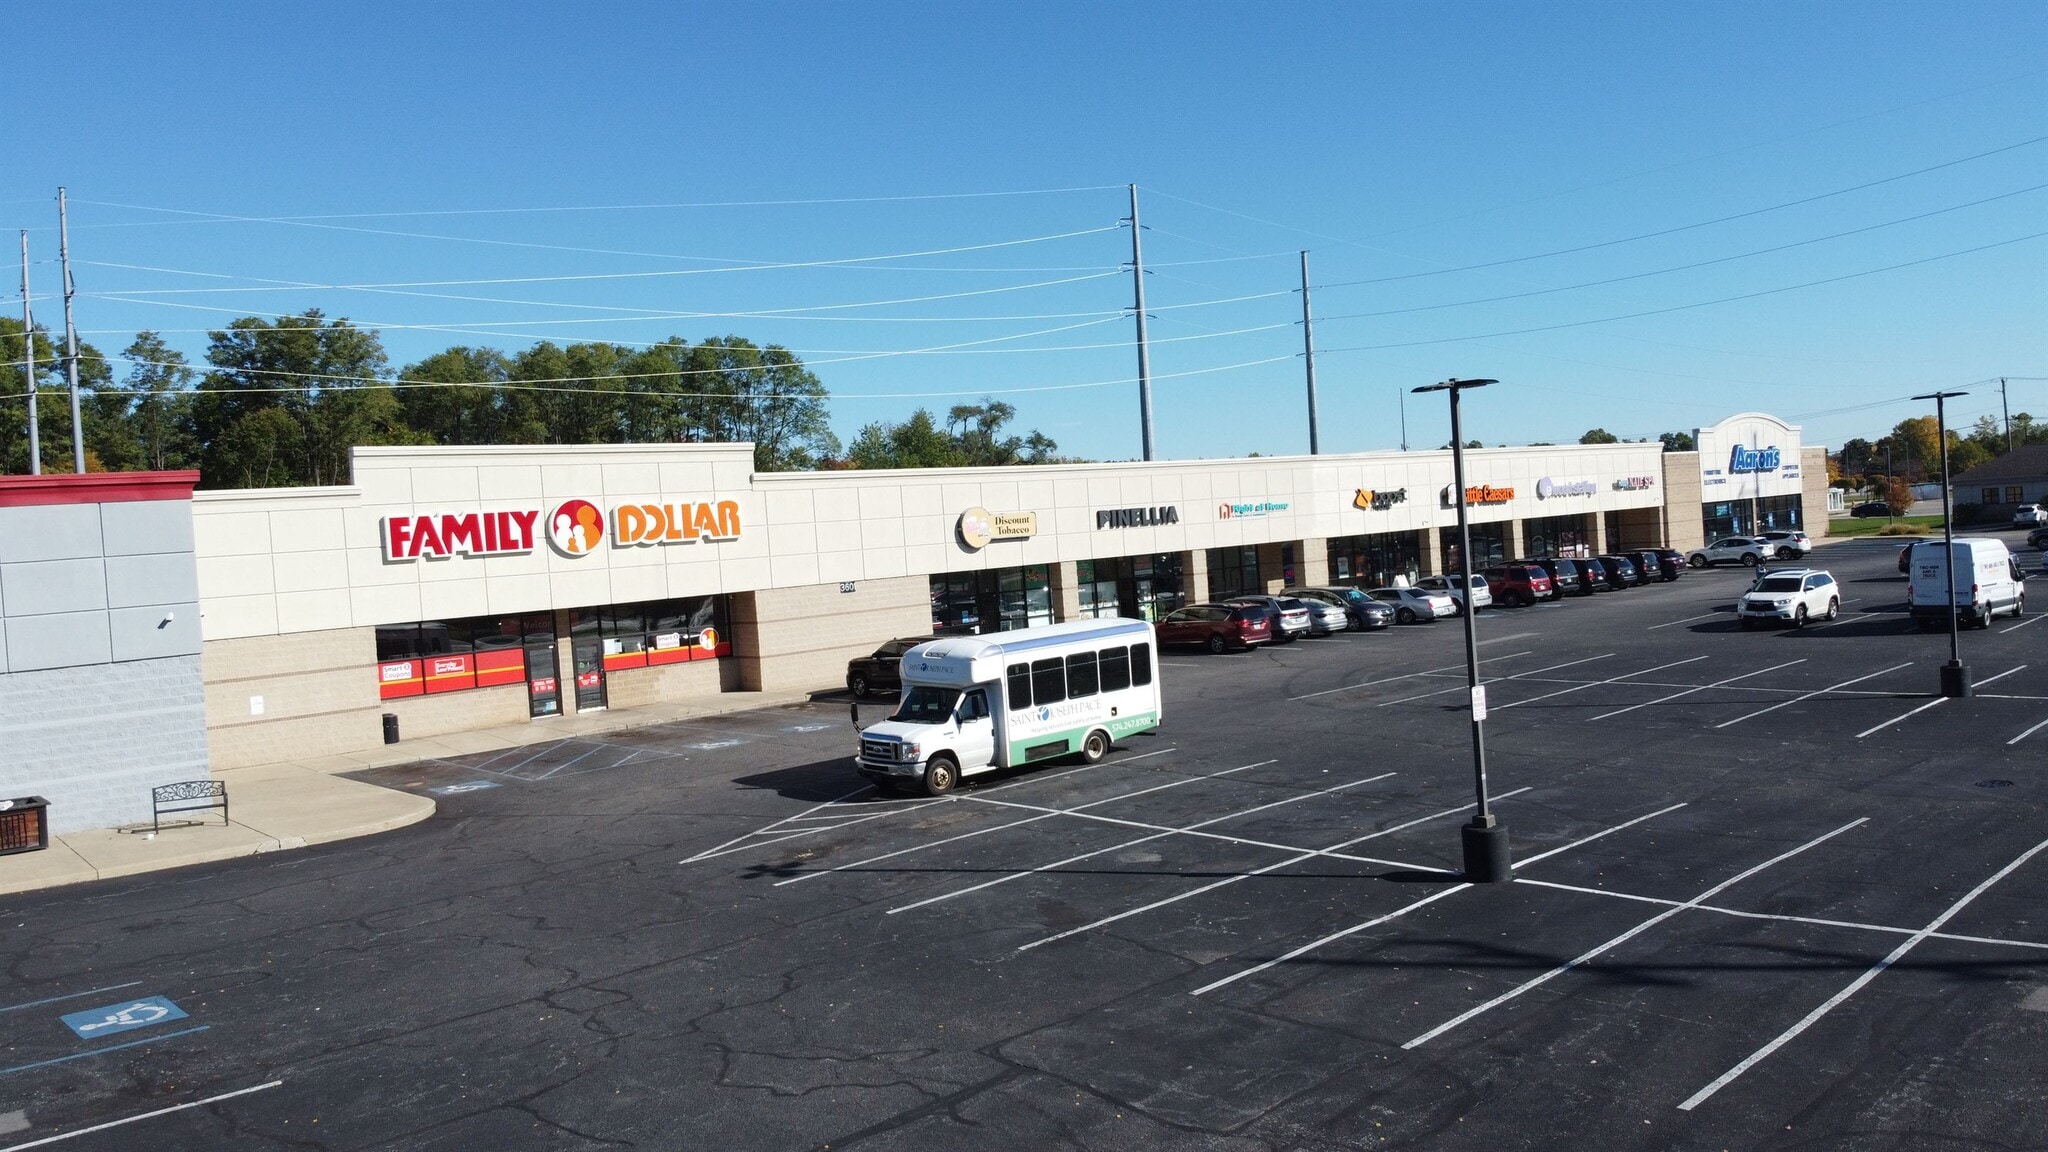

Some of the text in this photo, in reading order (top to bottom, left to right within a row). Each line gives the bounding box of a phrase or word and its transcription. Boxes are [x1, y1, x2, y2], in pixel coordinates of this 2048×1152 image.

[1734, 445, 1780, 470] Aaron's
[1464, 486, 1483, 503] ittle
[1483, 485, 1515, 502] Caesars
[995, 516, 1030, 525] Discount
[1097, 505, 1179, 530] PINELLIA
[388, 500, 742, 559] FAMILY DOLLAR
[997, 526, 1030, 535] Tobacco
[840, 583, 854, 592] 360
[1010, 711, 1036, 727] SAINT
[1079, 699, 1102, 712] PACE
